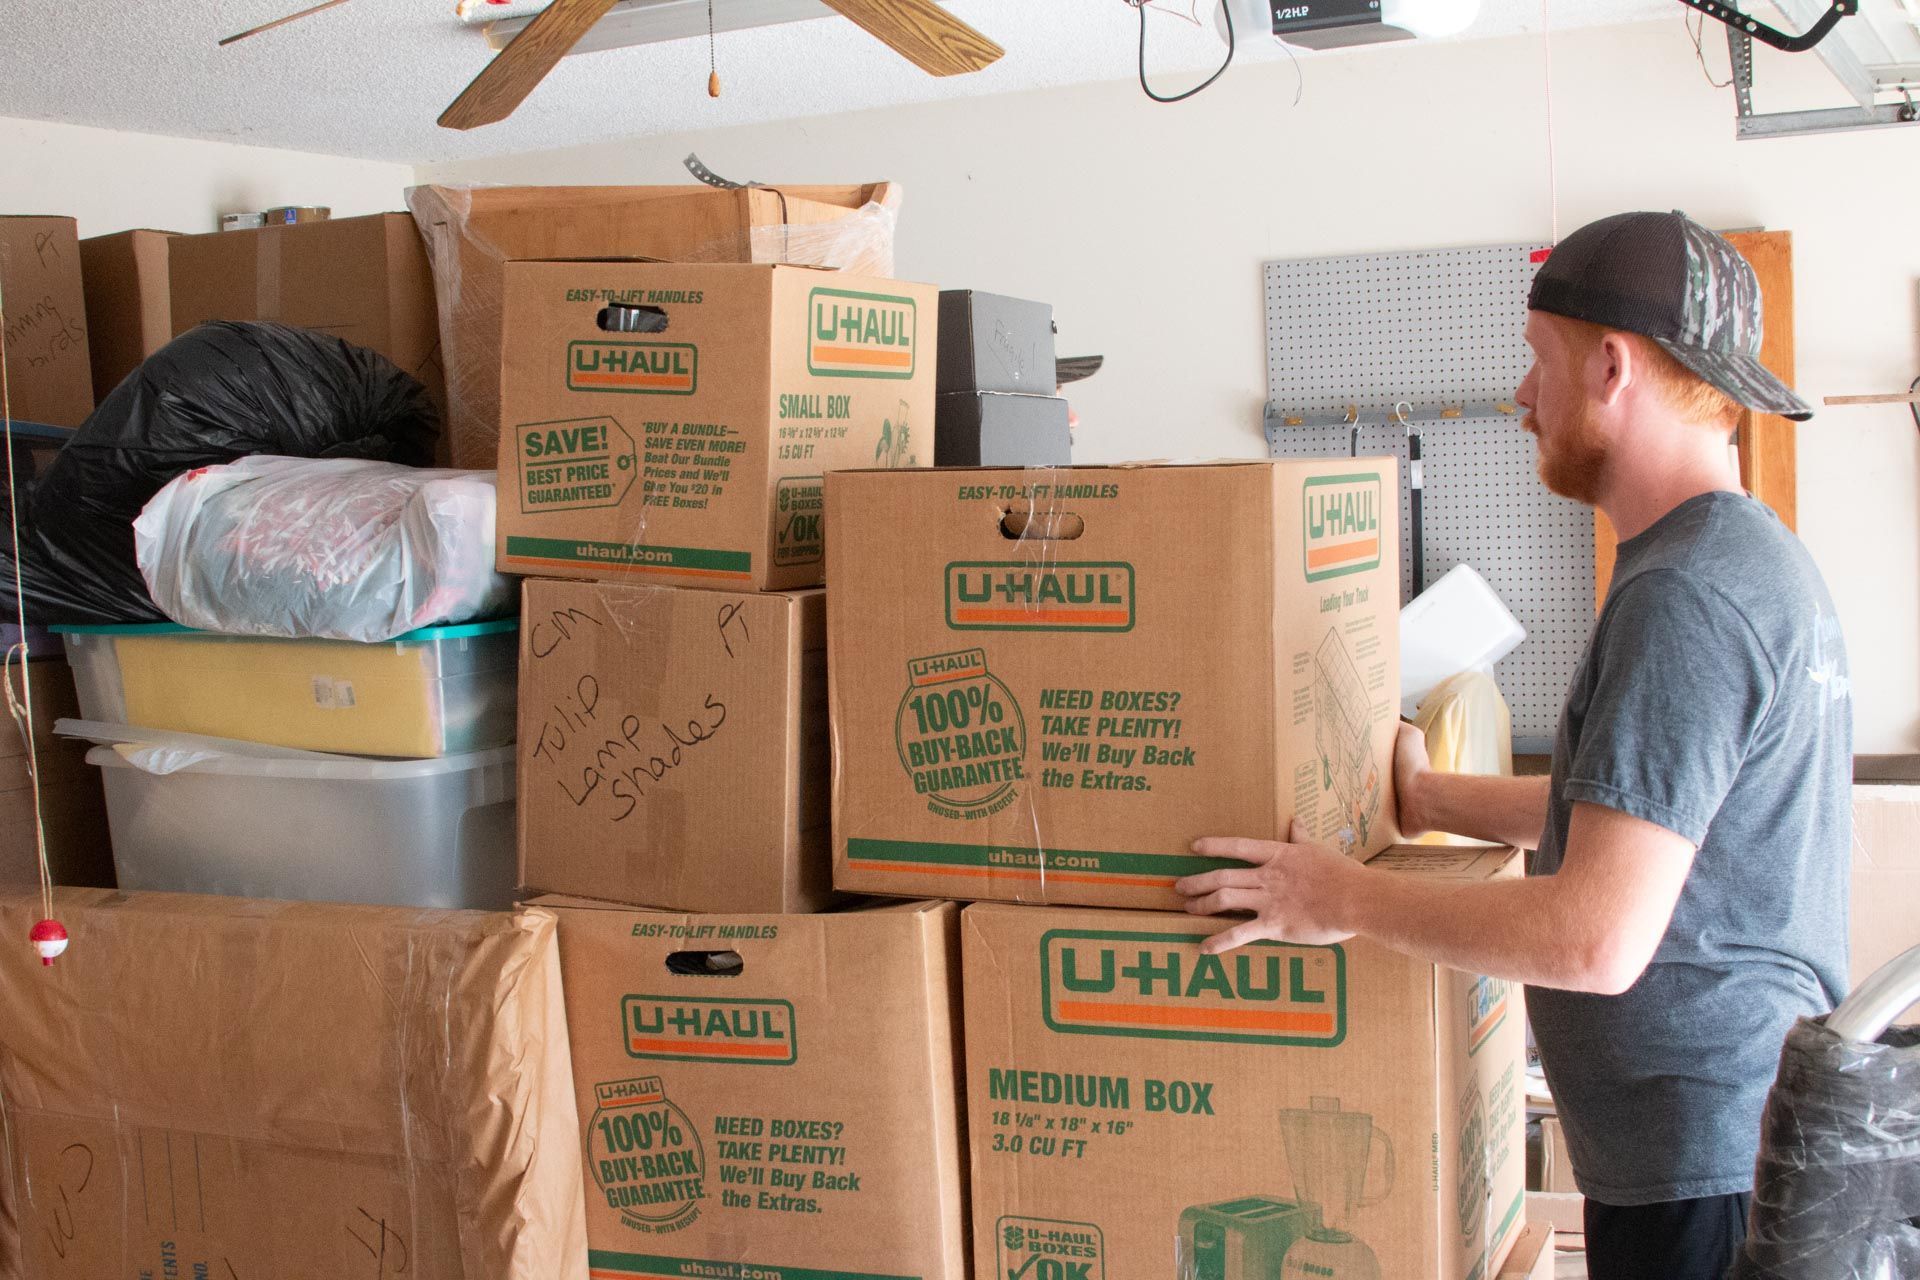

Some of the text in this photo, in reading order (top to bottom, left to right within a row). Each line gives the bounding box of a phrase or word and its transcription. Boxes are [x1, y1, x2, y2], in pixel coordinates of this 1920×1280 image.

[566, 289, 703, 303] EASY-TO-LIFT HANDLES
[779, 393, 851, 419] SMALL BOX
[671, 423, 678, 434] A
[525, 425, 608, 457] SAVE!
[645, 437, 746, 453] SAVE EVEN MORE!
[778, 444, 815, 459] 1.5 CU FT
[644, 452, 730, 467] Beat Our Bundle
[527, 463, 609, 486] BEST PRICE
[643, 466, 730, 481] Prices and We'll
[643, 480, 723, 496] Give You $20 in
[791, 487, 823, 497] U-HAUL
[958, 484, 1119, 499] EASY-TO-LIFT HANDLES
[642, 495, 709, 509] FREE Boxes!
[791, 499, 823, 511] BOXES
[793, 514, 820, 541] OK
[577, 544, 673, 562] uhaul.com
[913, 653, 981, 676] U-HAUL
[909, 684, 1004, 734] 100%
[1040, 689, 1181, 711] NEED BOXES?
[1041, 715, 1181, 738] TAKE PLENTY!
[908, 726, 1019, 767] BUY-BACK
[1042, 742, 1196, 768] We'll Buy Back
[913, 757, 1025, 794] GUARANTEE
[1042, 768, 1152, 791] the Extras.
[989, 788, 1019, 815] RECEIPT
[989, 850, 1099, 868] uhaul.com
[631, 923, 778, 939] EASY-TO-LIFT HANDLES
[599, 1081, 660, 1099] U-HAUL
[989, 1068, 1215, 1116] MEDIUM BOX
[598, 1109, 683, 1153] 100%
[715, 1116, 844, 1140] NEED BOXES?
[992, 1111, 1010, 1126] 18
[1045, 1118, 1054, 1130] x
[1060, 1117, 1087, 1132] 18"
[1091, 1122, 1100, 1134] x
[1106, 1120, 1134, 1135] 16"
[717, 1141, 846, 1165] TAKE PLENTY!
[992, 1133, 1088, 1158] 3.0 CU FT
[1431, 1133, 1439, 1152] MED
[600, 1150, 698, 1184] BUY-BACK
[720, 1165, 861, 1191] We'll Buy Back
[606, 1178, 705, 1208] GUARANTEE
[722, 1189, 822, 1214] the Extras.
[676, 1207, 702, 1231] RECEIPT
[1028, 1229, 1096, 1245] U-HAUL
[1028, 1241, 1097, 1258] BOXES
[680, 1262, 782, 1280] uhaul.com
[1037, 1259, 1092, 1280] OK
